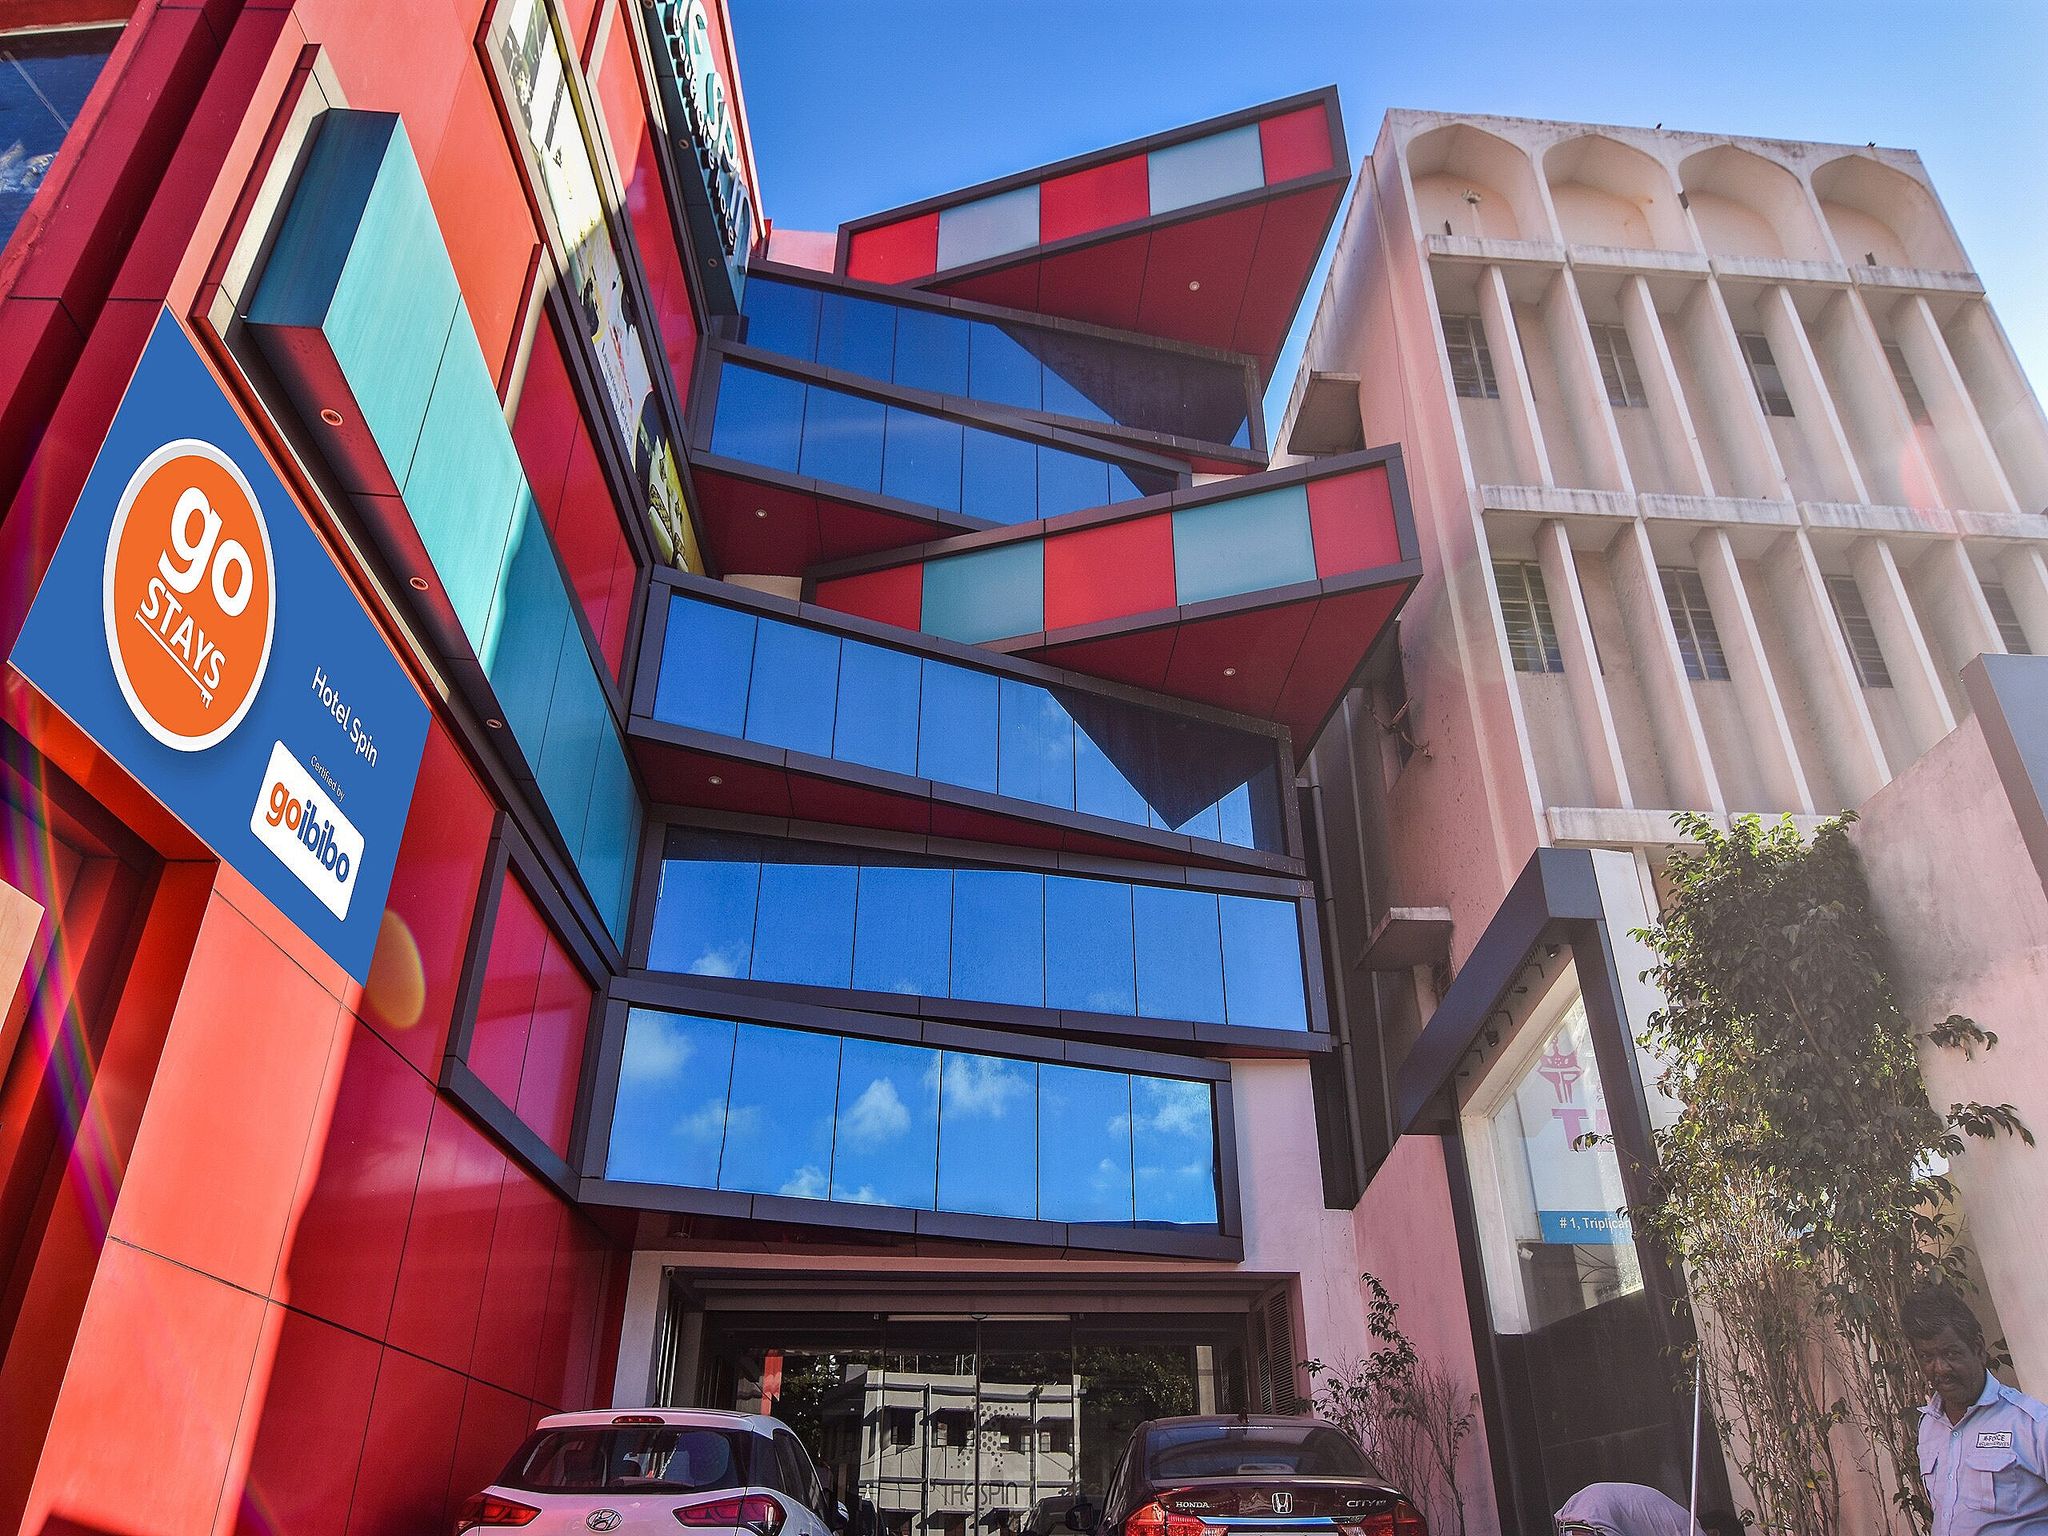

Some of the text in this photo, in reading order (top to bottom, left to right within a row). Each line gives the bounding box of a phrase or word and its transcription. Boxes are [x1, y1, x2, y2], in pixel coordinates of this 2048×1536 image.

[158, 487, 254, 617] go
[141, 576, 226, 691] STAYS
[311, 666, 378, 768] Hotel Spin
[311, 755, 345, 802] Certified by
[266, 781, 349, 883] goibibo
[1176, 1501, 1210, 1509] HONDA
